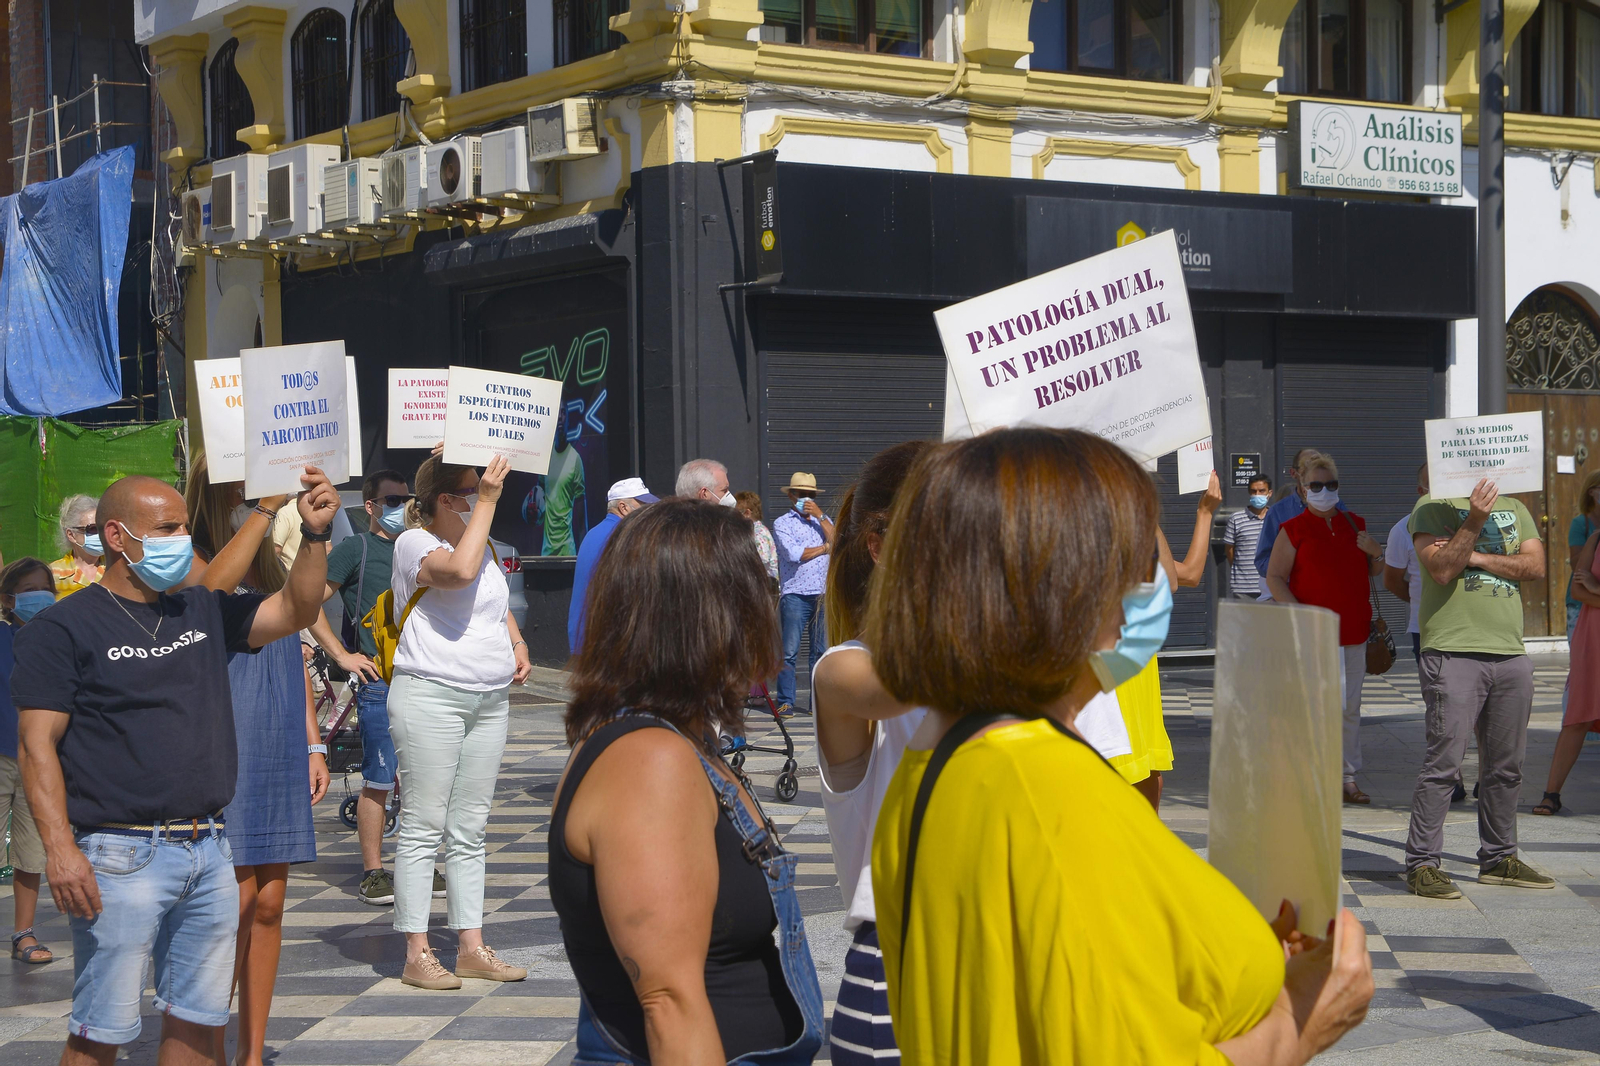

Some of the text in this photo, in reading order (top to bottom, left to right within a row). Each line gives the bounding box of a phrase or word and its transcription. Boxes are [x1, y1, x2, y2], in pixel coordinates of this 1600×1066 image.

[1362, 113, 1454, 145] Análisis
[1363, 145, 1455, 177] Clínicos
[1303, 170, 1458, 193] Rafael Ochando 956 63 15 68
[766, 186, 774, 228] emotion
[1180, 248, 1211, 266] tion
[966, 268, 1164, 354] PATOLOGÍA DUAL,
[980, 302, 1171, 388] UN PROBLEMA AL
[210, 374, 243, 390] ALT
[282, 370, 318, 390] TOD@S
[486, 383, 532, 398] CENTROS
[1033, 350, 1143, 409] RESOLVER
[274, 398, 330, 420] CONTRA EL
[458, 394, 550, 416] ESPECÍFICOS PARA
[1120, 420, 1129, 429] DE
[1130, 394, 1193, 426] DRODEPENDENCIAS
[468, 410, 542, 429] LOS ENFERMOS
[1456, 424, 1514, 436] MÁS MEDIOS
[262, 421, 338, 446] NARCOTRAFICO
[488, 428, 524, 441] DUALES
[1121, 422, 1155, 440] FRONTERA
[1441, 434, 1529, 448] PARA LAS FUERZAS
[1457, 446, 1510, 457] SEGURIDAD
[1513, 445, 1530, 454] DEL
[1469, 458, 1505, 468] ESTADO
[150, 630, 194, 657] COAST
